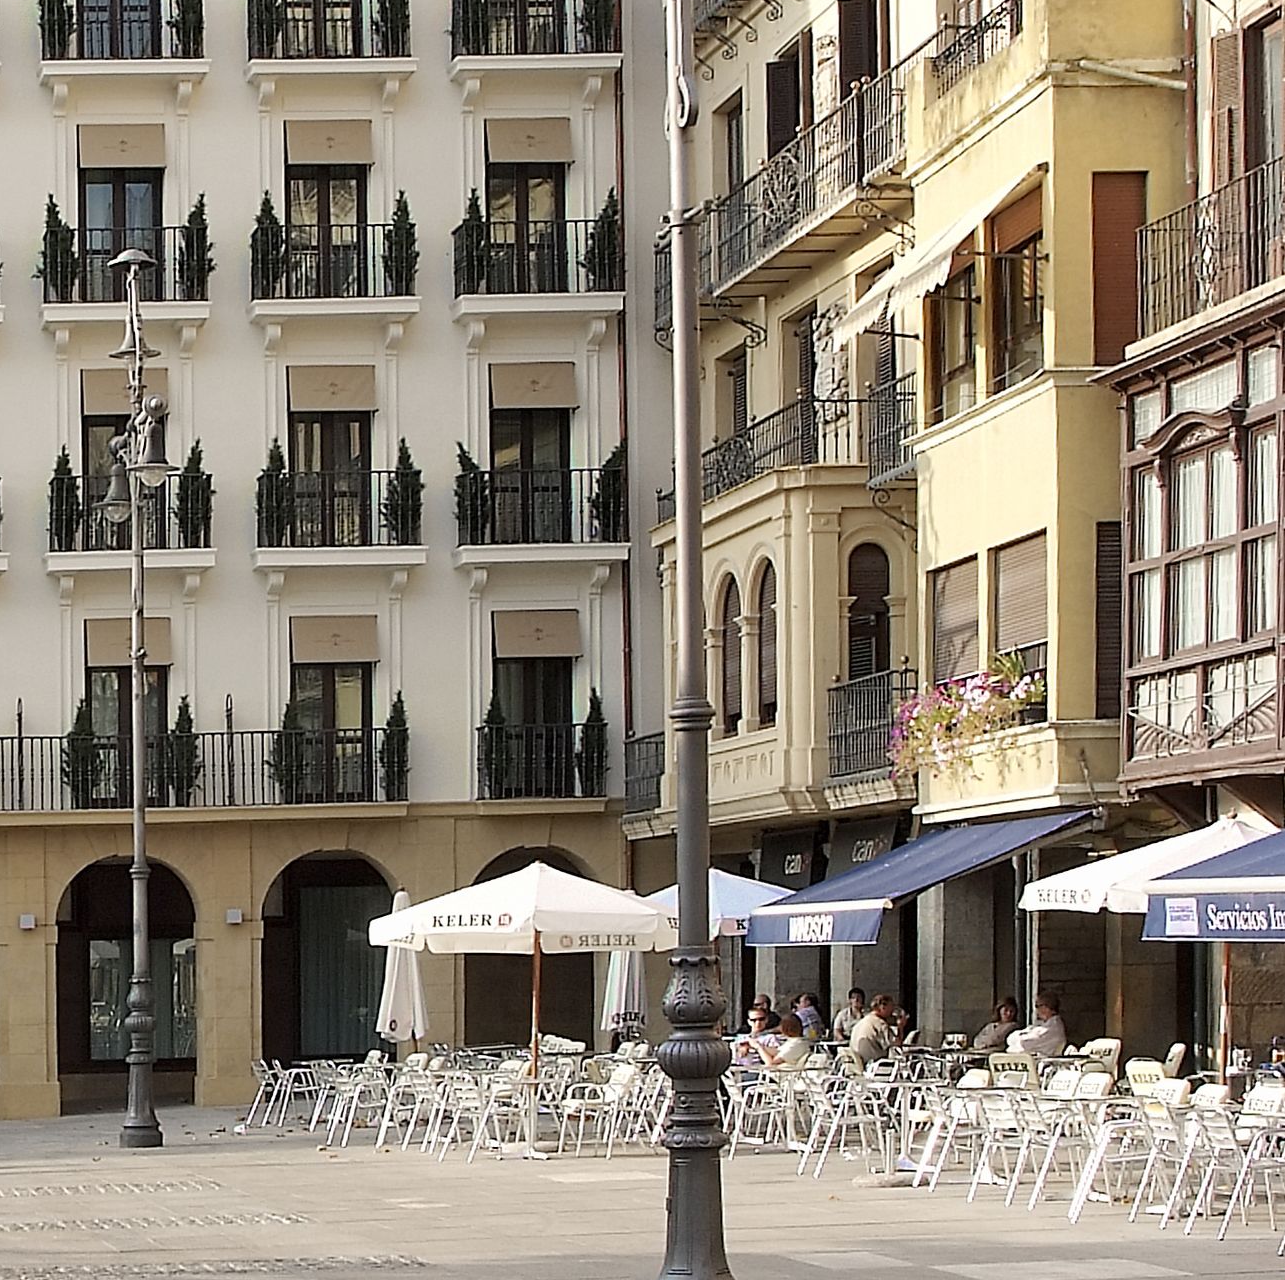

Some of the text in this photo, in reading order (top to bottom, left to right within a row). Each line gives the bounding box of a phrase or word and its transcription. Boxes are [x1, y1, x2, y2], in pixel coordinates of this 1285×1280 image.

[1037, 888, 1078, 904] KELER
[432, 914, 493, 928] KELER
[1206, 902, 1268, 931] Servicios
